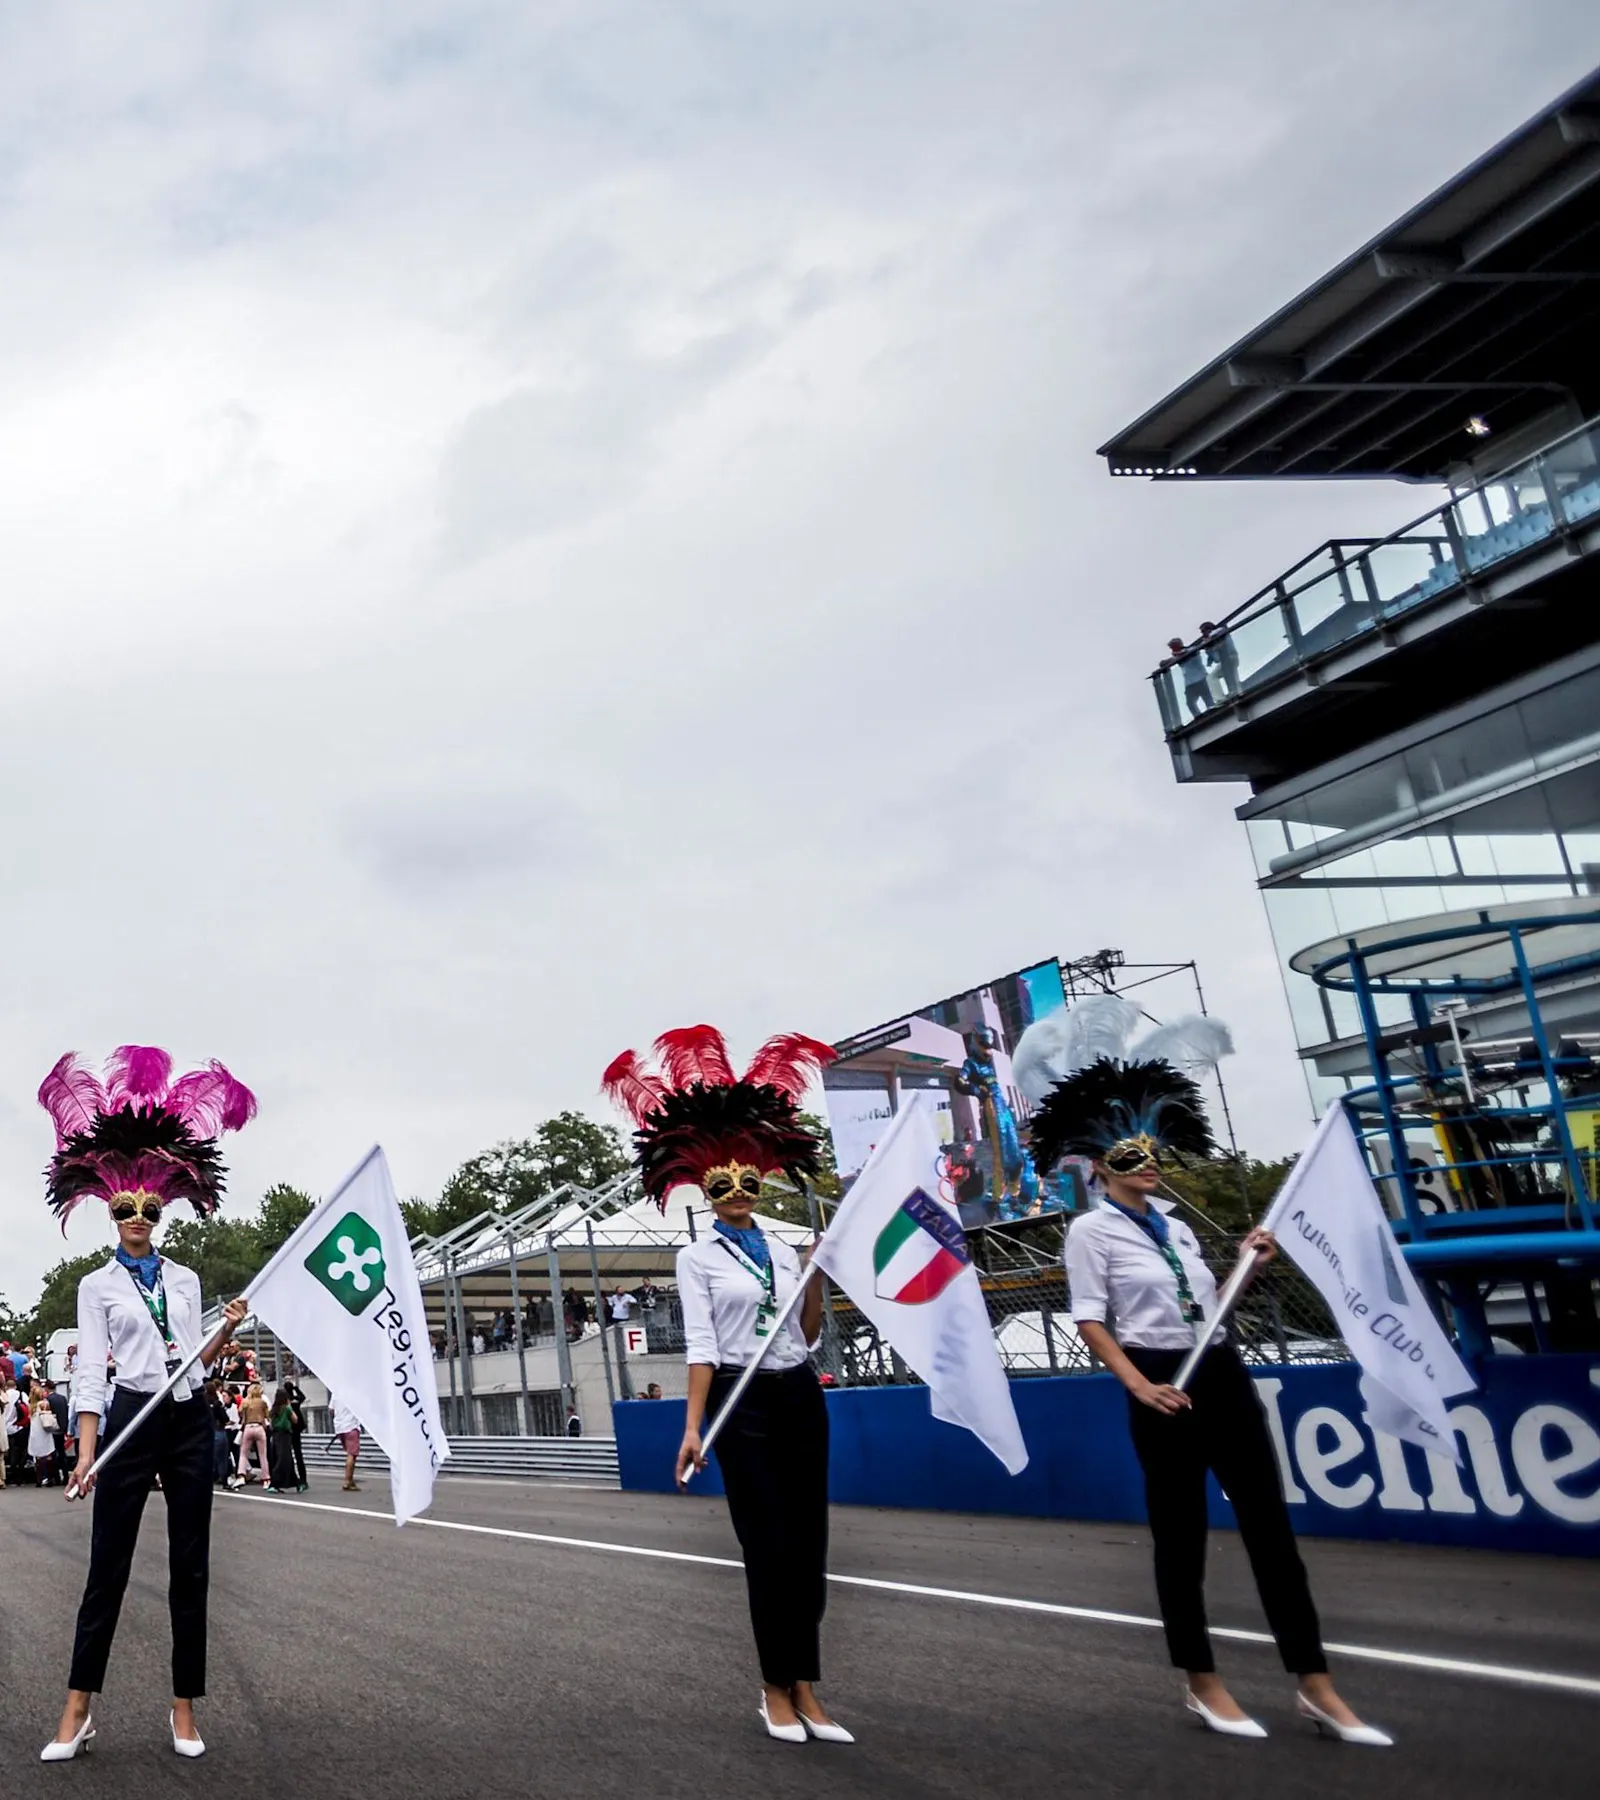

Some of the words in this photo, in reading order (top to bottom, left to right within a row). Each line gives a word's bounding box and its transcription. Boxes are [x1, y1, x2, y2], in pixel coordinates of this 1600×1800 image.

[909, 1198, 971, 1259] ITALIA
[628, 1331, 642, 1351] F
[1369, 1311, 1425, 1364] Club
